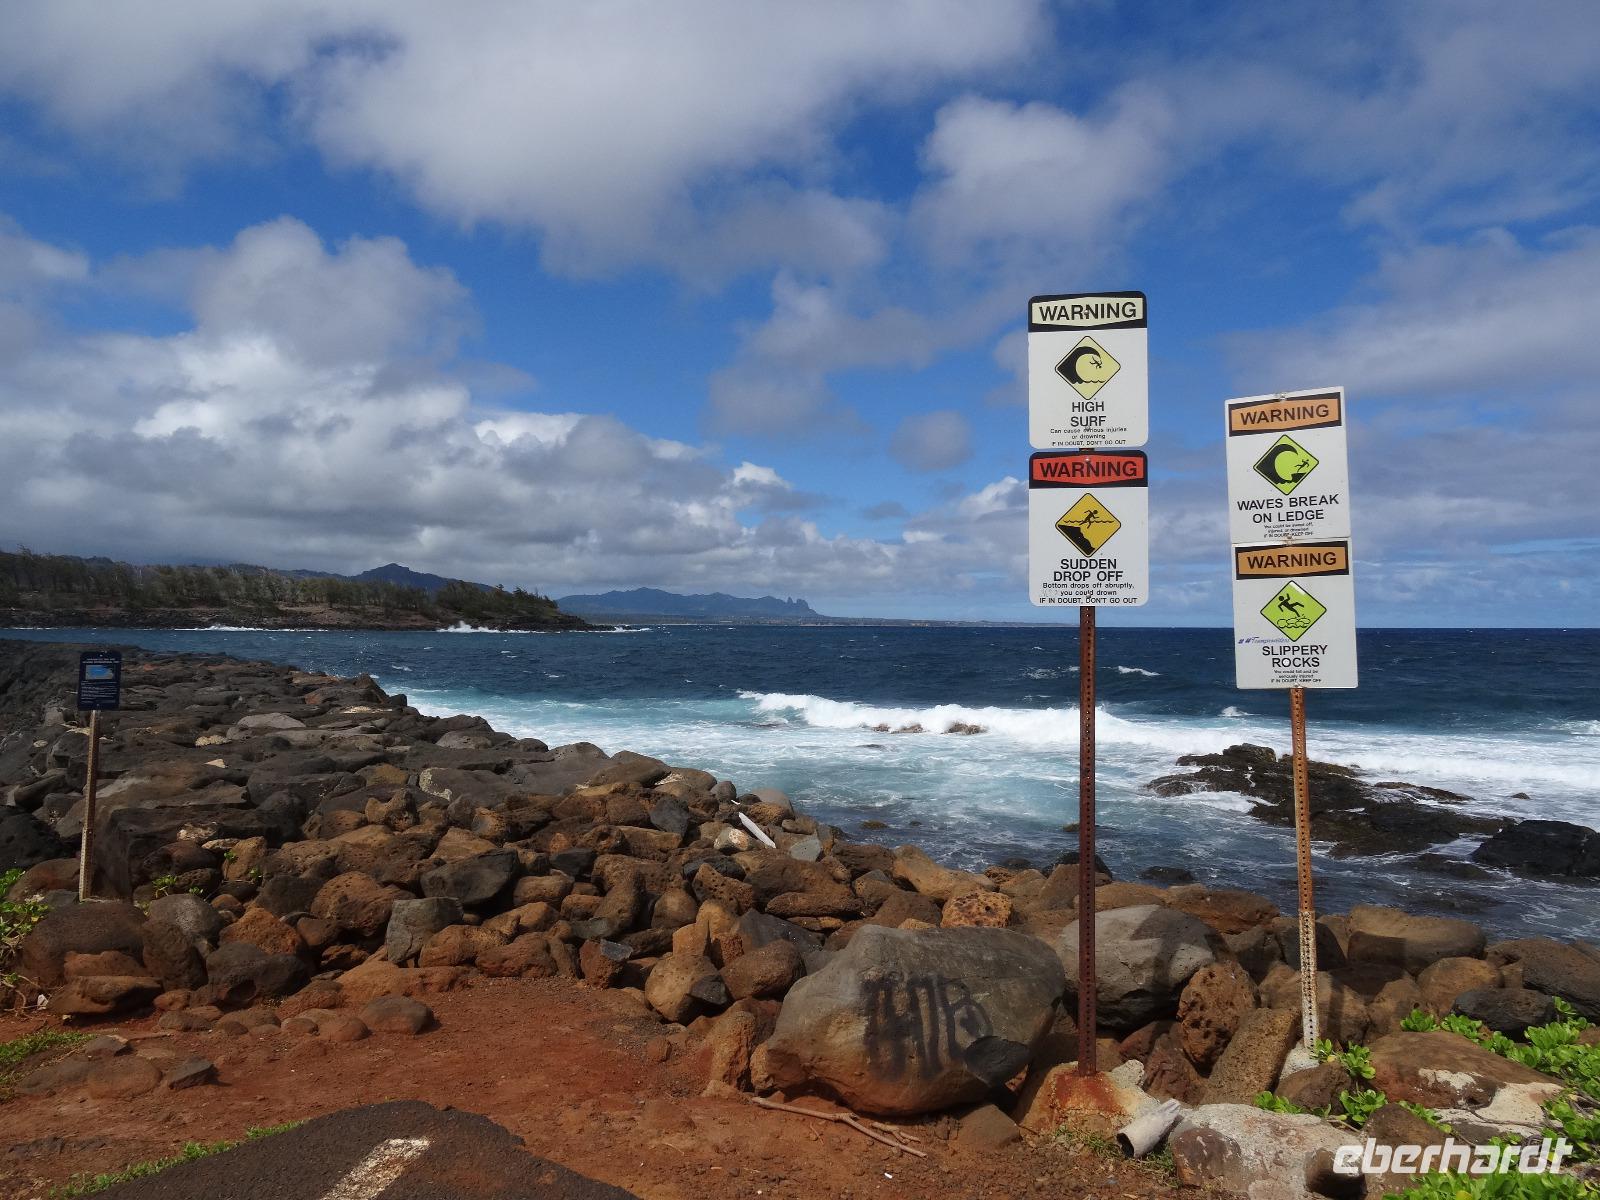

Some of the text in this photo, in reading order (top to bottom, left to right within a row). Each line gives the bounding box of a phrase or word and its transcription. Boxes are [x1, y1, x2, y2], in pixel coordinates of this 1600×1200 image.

[1039, 302, 1136, 322] WARNING
[1072, 401, 1104, 412] HIGH
[1070, 416, 1106, 427] SURF
[1240, 404, 1329, 426] WARNING
[1040, 460, 1137, 478] WARNING
[1237, 494, 1339, 510] WAVES BREAK
[1252, 510, 1324, 524] ON LEDGE
[1060, 558, 1117, 570] SUDDEN
[1247, 551, 1336, 570] WARNING
[1054, 571, 1124, 582] DROP OFF
[1262, 644, 1328, 656] SLIPPERY
[1272, 657, 1320, 668] ROCKS
